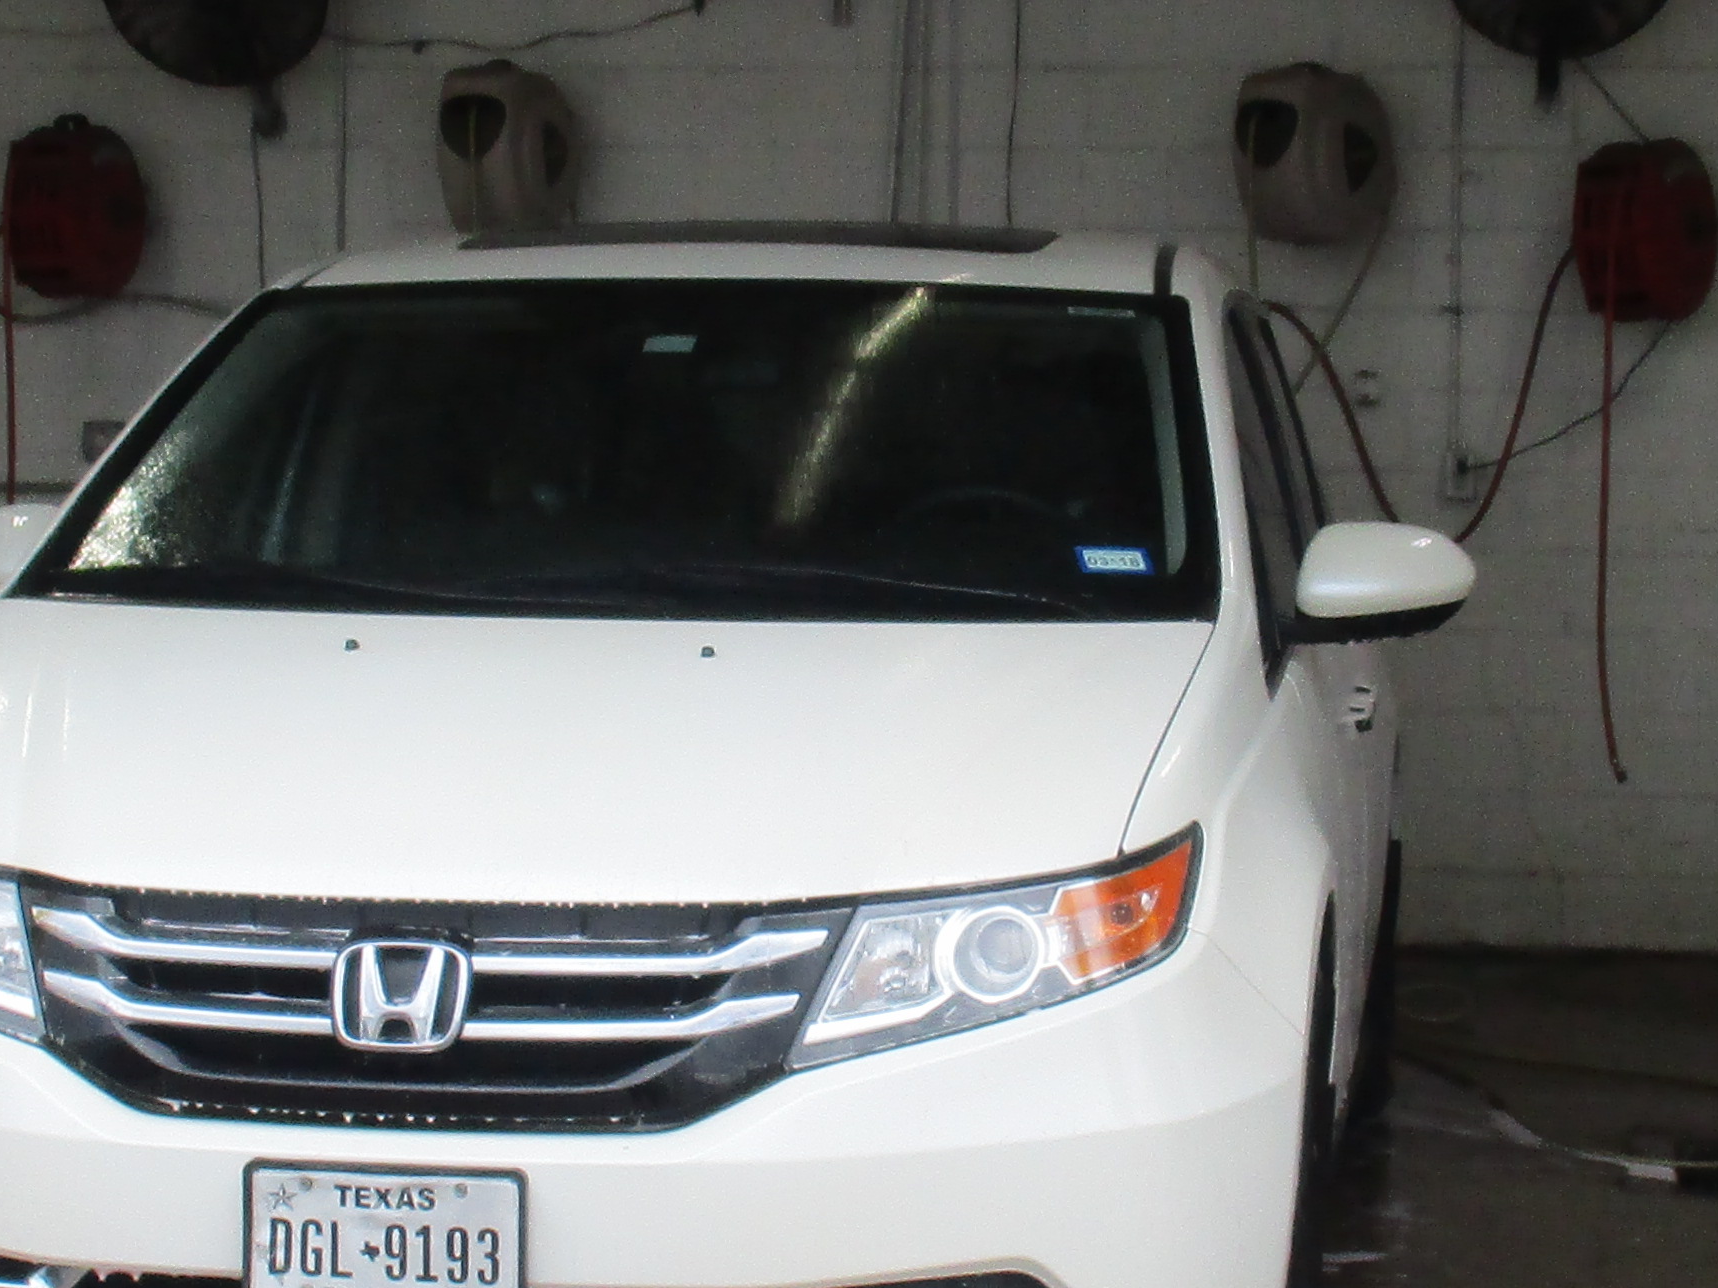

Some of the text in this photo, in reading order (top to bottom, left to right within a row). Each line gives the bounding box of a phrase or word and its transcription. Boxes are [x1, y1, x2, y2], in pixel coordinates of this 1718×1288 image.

[334, 1183, 437, 1211] TEXAS
[268, 1216, 501, 1286] DGL 9193
